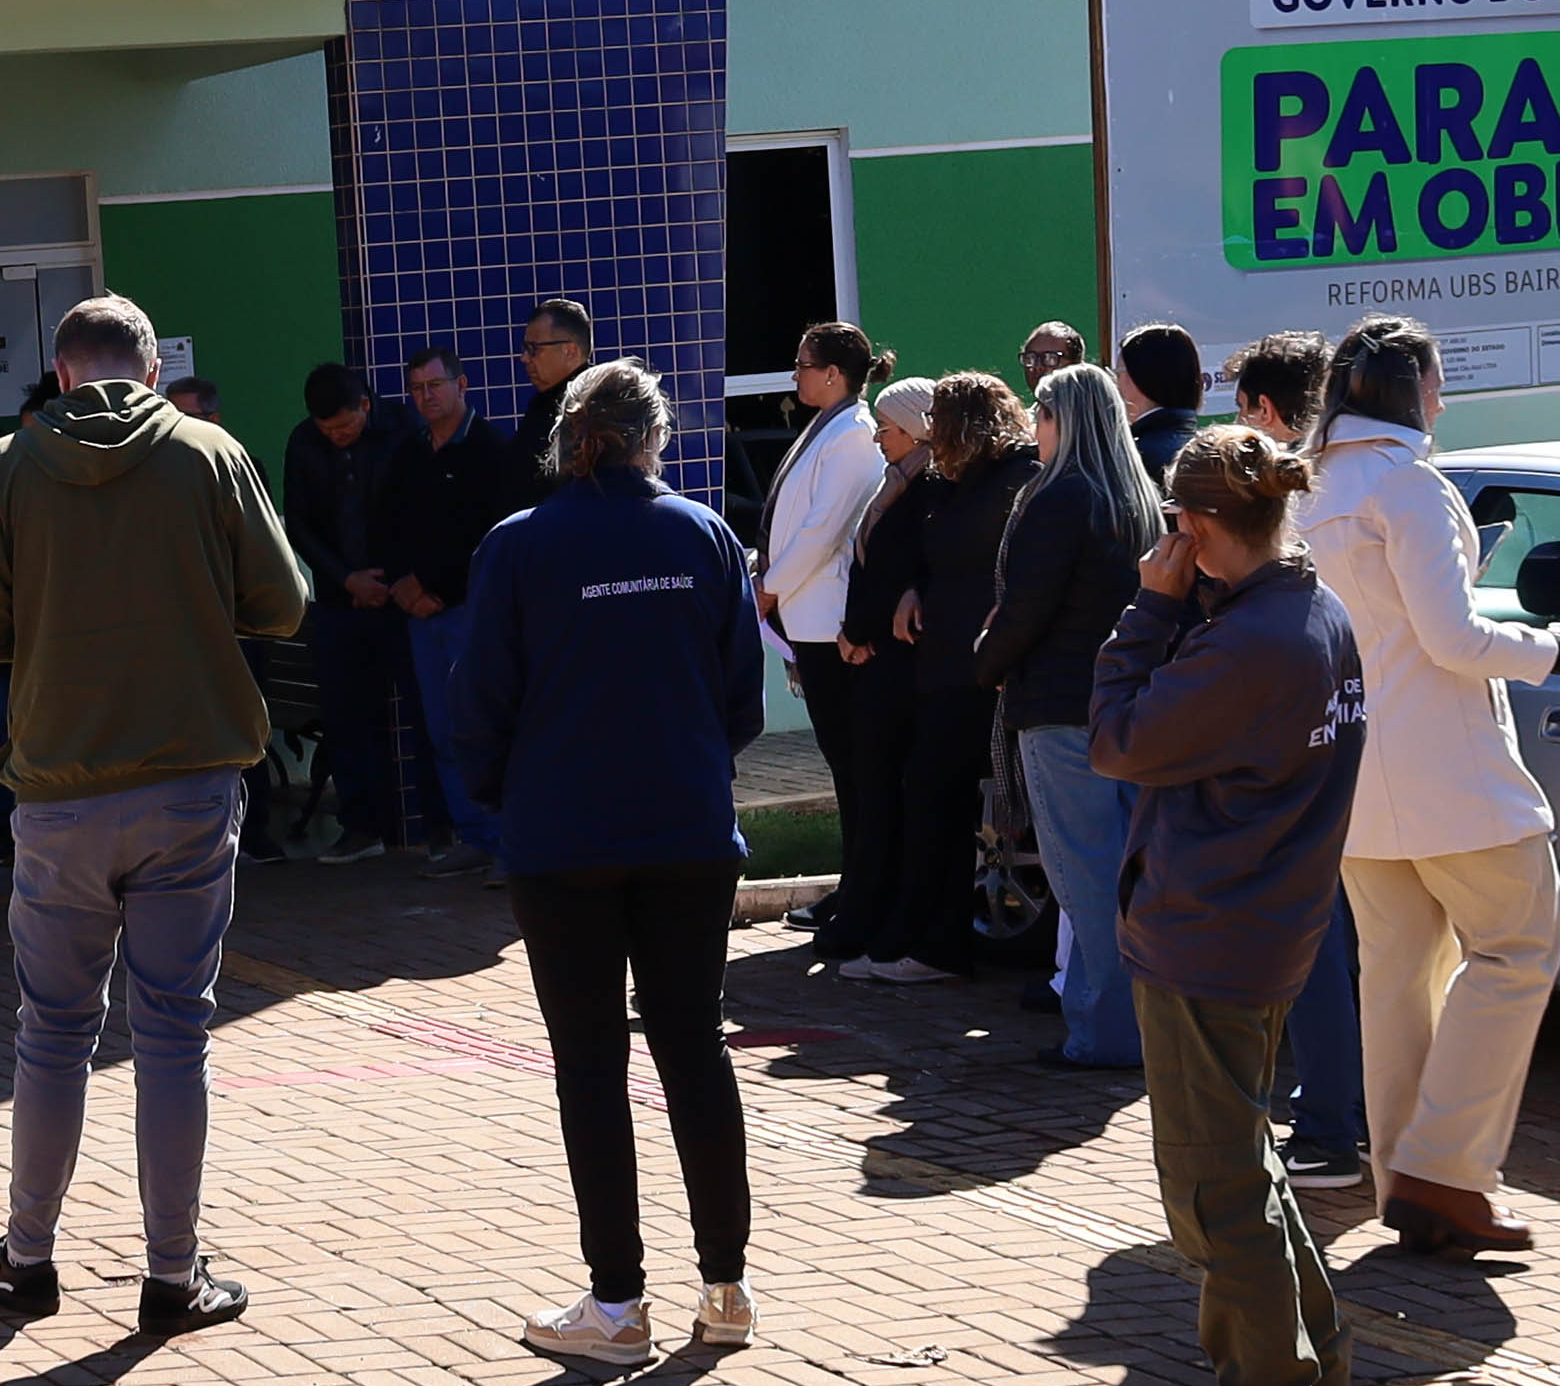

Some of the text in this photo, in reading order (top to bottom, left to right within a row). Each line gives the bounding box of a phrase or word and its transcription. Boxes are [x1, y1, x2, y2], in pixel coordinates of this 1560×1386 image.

[1252, 170, 1398, 261] EM
[1327, 277, 1443, 307] REFORMA
[1449, 272, 1497, 299] UBS
[581, 582, 611, 600] AGENTE
[660, 576, 671, 590] DE
